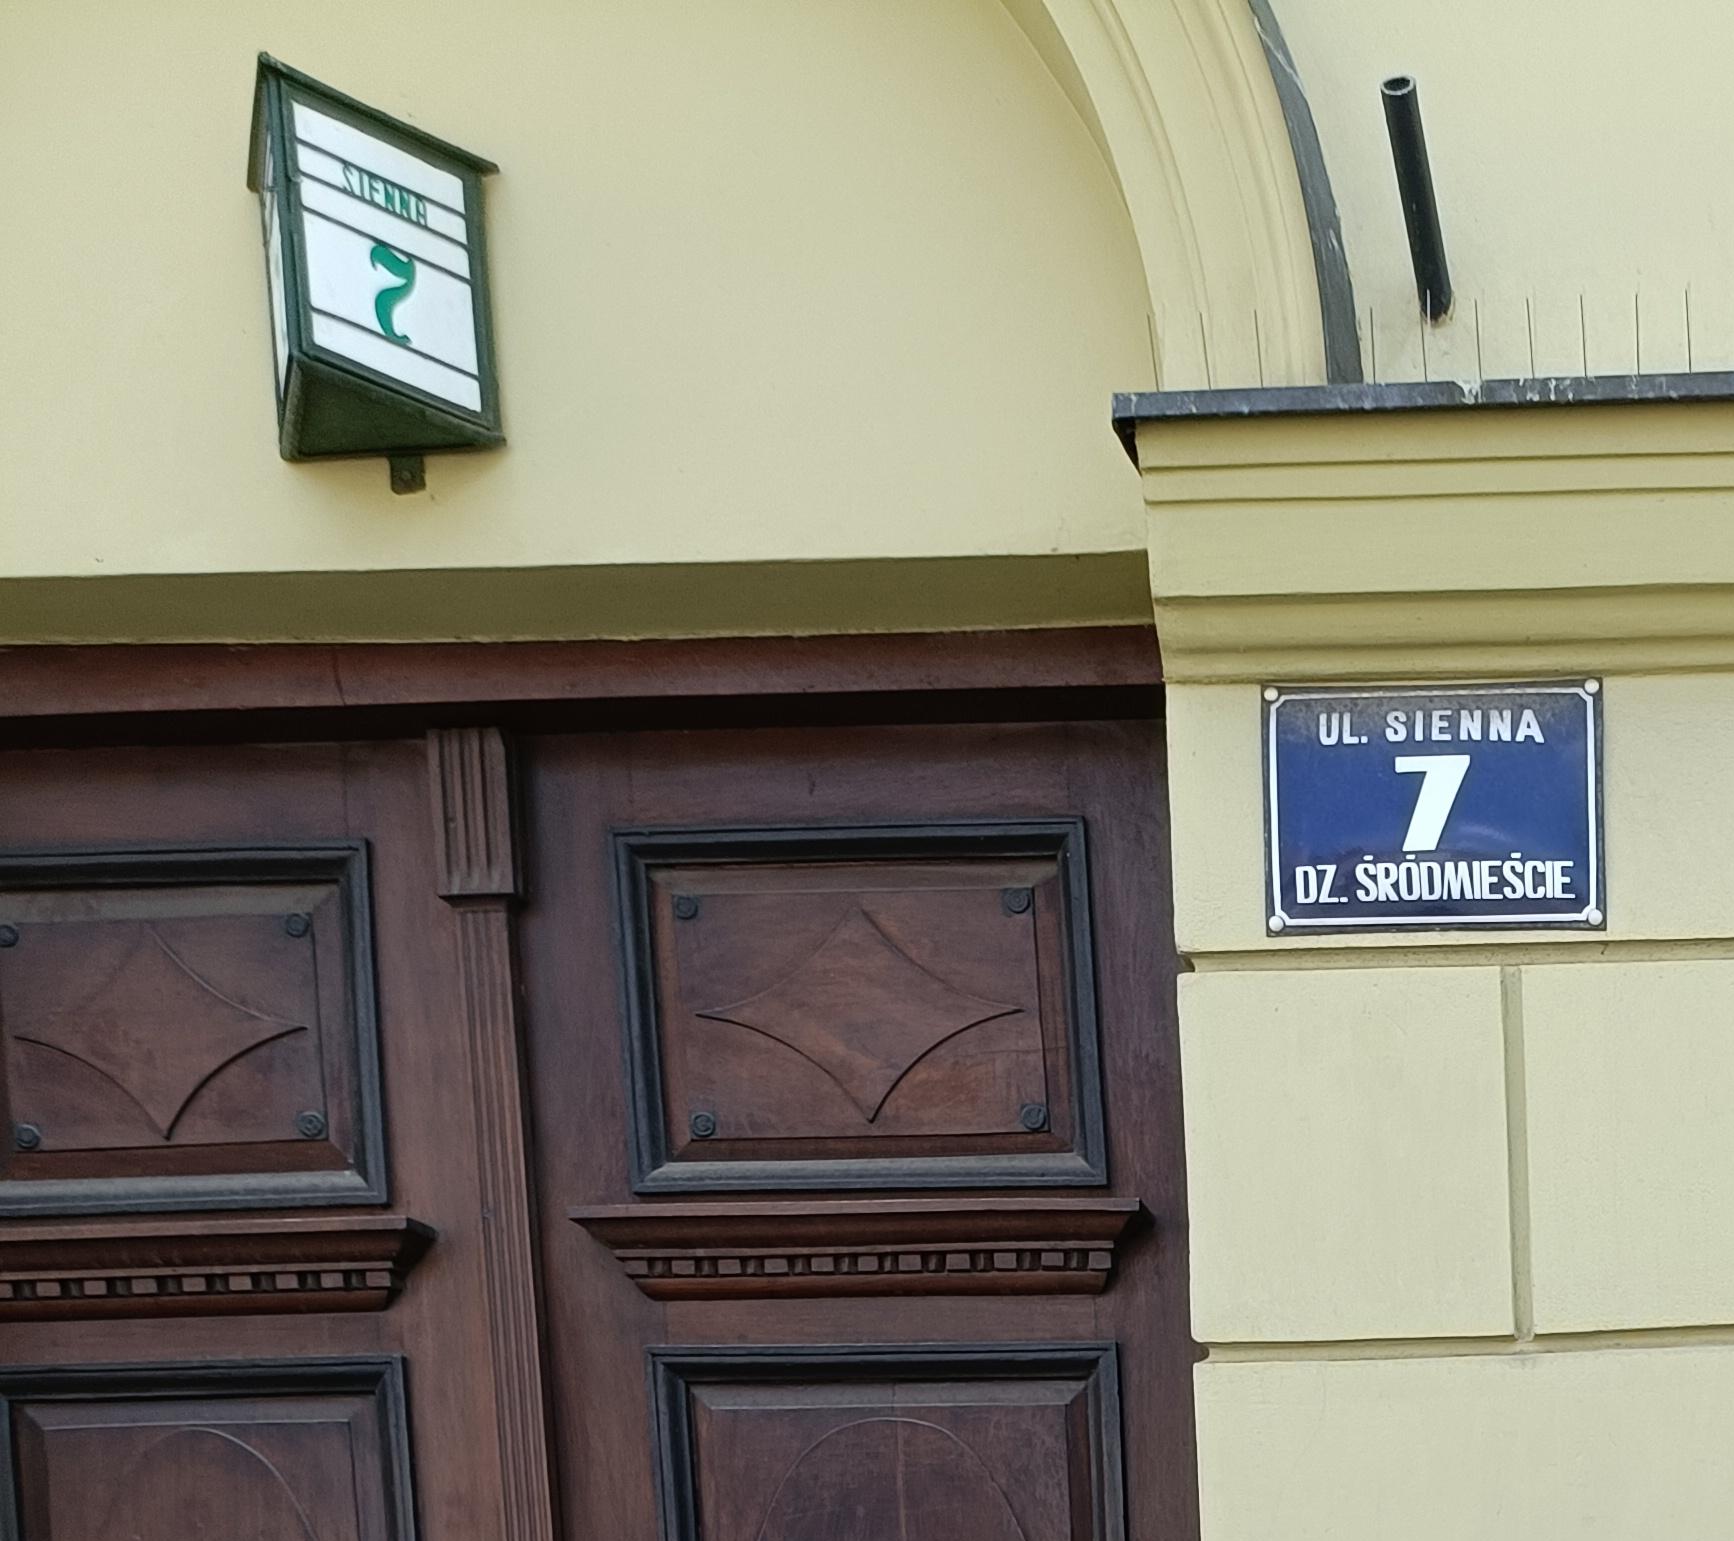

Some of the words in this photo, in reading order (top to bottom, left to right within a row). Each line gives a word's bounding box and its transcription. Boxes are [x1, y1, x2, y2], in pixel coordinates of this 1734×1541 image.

[342, 162, 428, 230] SIENNA
[370, 241, 417, 345] 7
[1318, 712, 1369, 746] UL.
[1385, 708, 1546, 744] SIENNA
[1394, 754, 1472, 853] 7
[1295, 864, 1349, 904] DZ.
[1355, 852, 1577, 902] ŚRÓDMIEŚCIE
